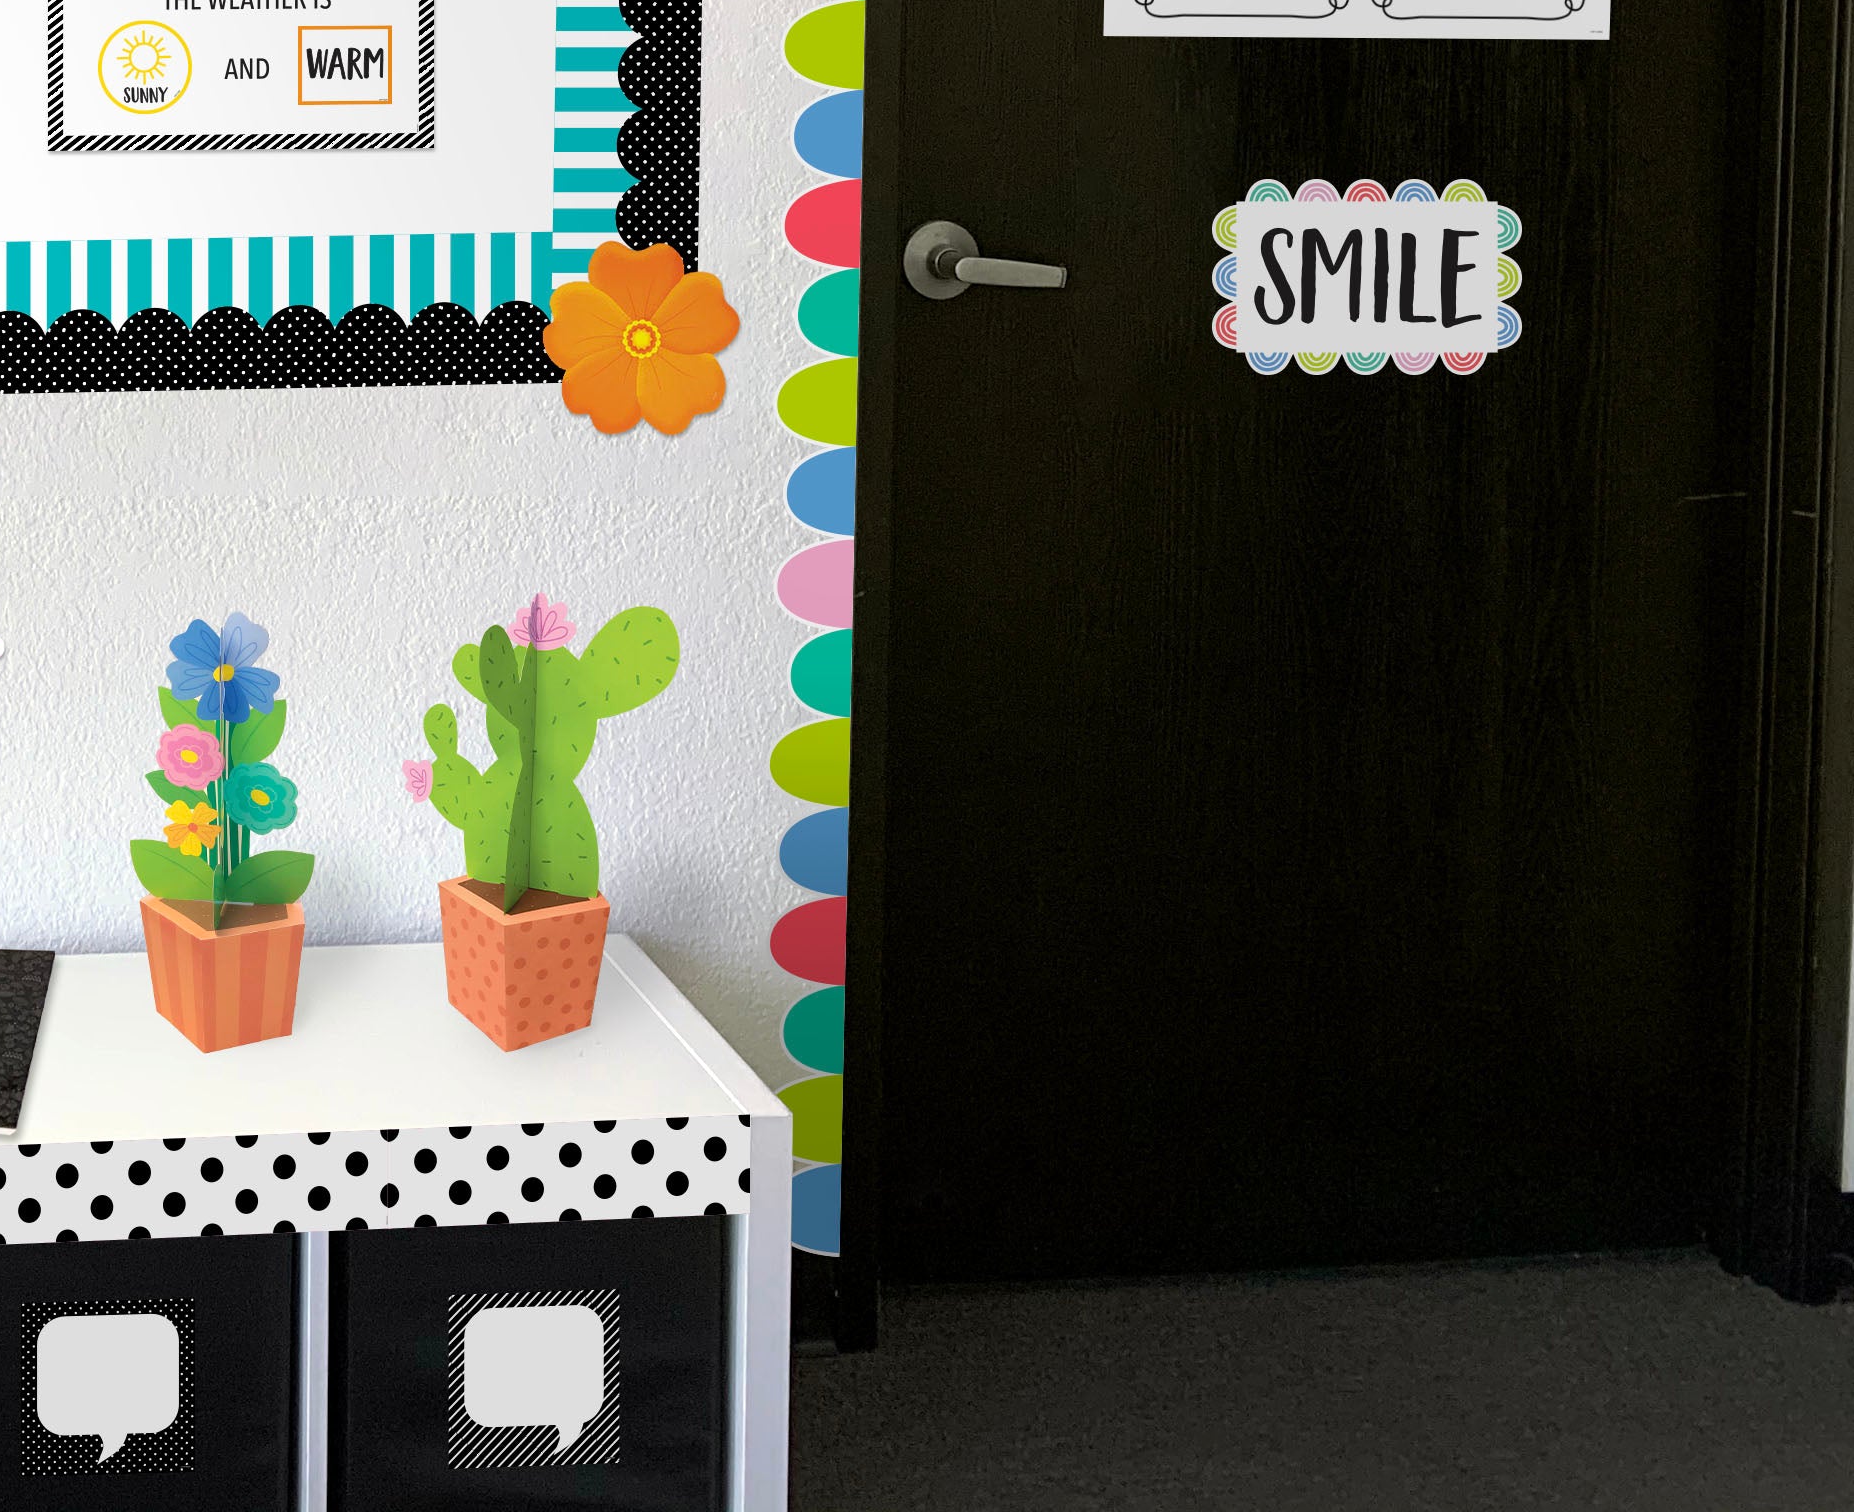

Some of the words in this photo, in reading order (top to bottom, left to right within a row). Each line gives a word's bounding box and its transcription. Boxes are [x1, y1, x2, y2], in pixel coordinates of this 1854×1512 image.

[225, 58, 269, 79] AND
[307, 48, 383, 80] WARM
[124, 87, 168, 103] SUNNY
[1254, 228, 1482, 328] SMILE
